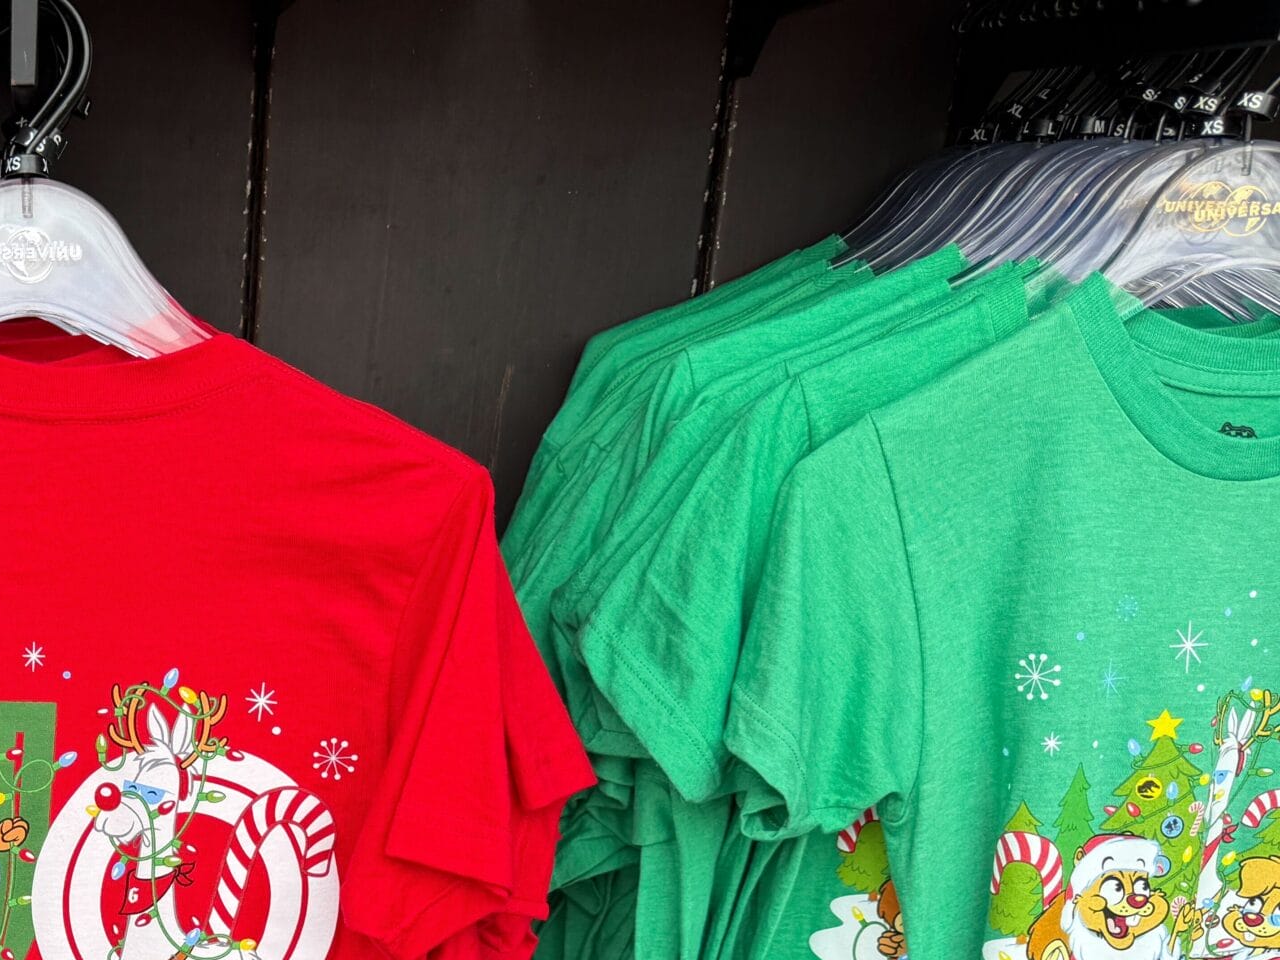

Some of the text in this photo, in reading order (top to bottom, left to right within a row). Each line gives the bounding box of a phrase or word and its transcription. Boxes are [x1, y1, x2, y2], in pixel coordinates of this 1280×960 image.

[1193, 96, 1218, 112] XS
[1237, 92, 1263, 109] XS
[1047, 122, 1055, 135] L
[1094, 119, 1105, 134] M
[1113, 124, 1124, 137] S
[1201, 120, 1224, 135] XS
[970, 128, 988, 141] XL
[5, 156, 21, 174] XS
